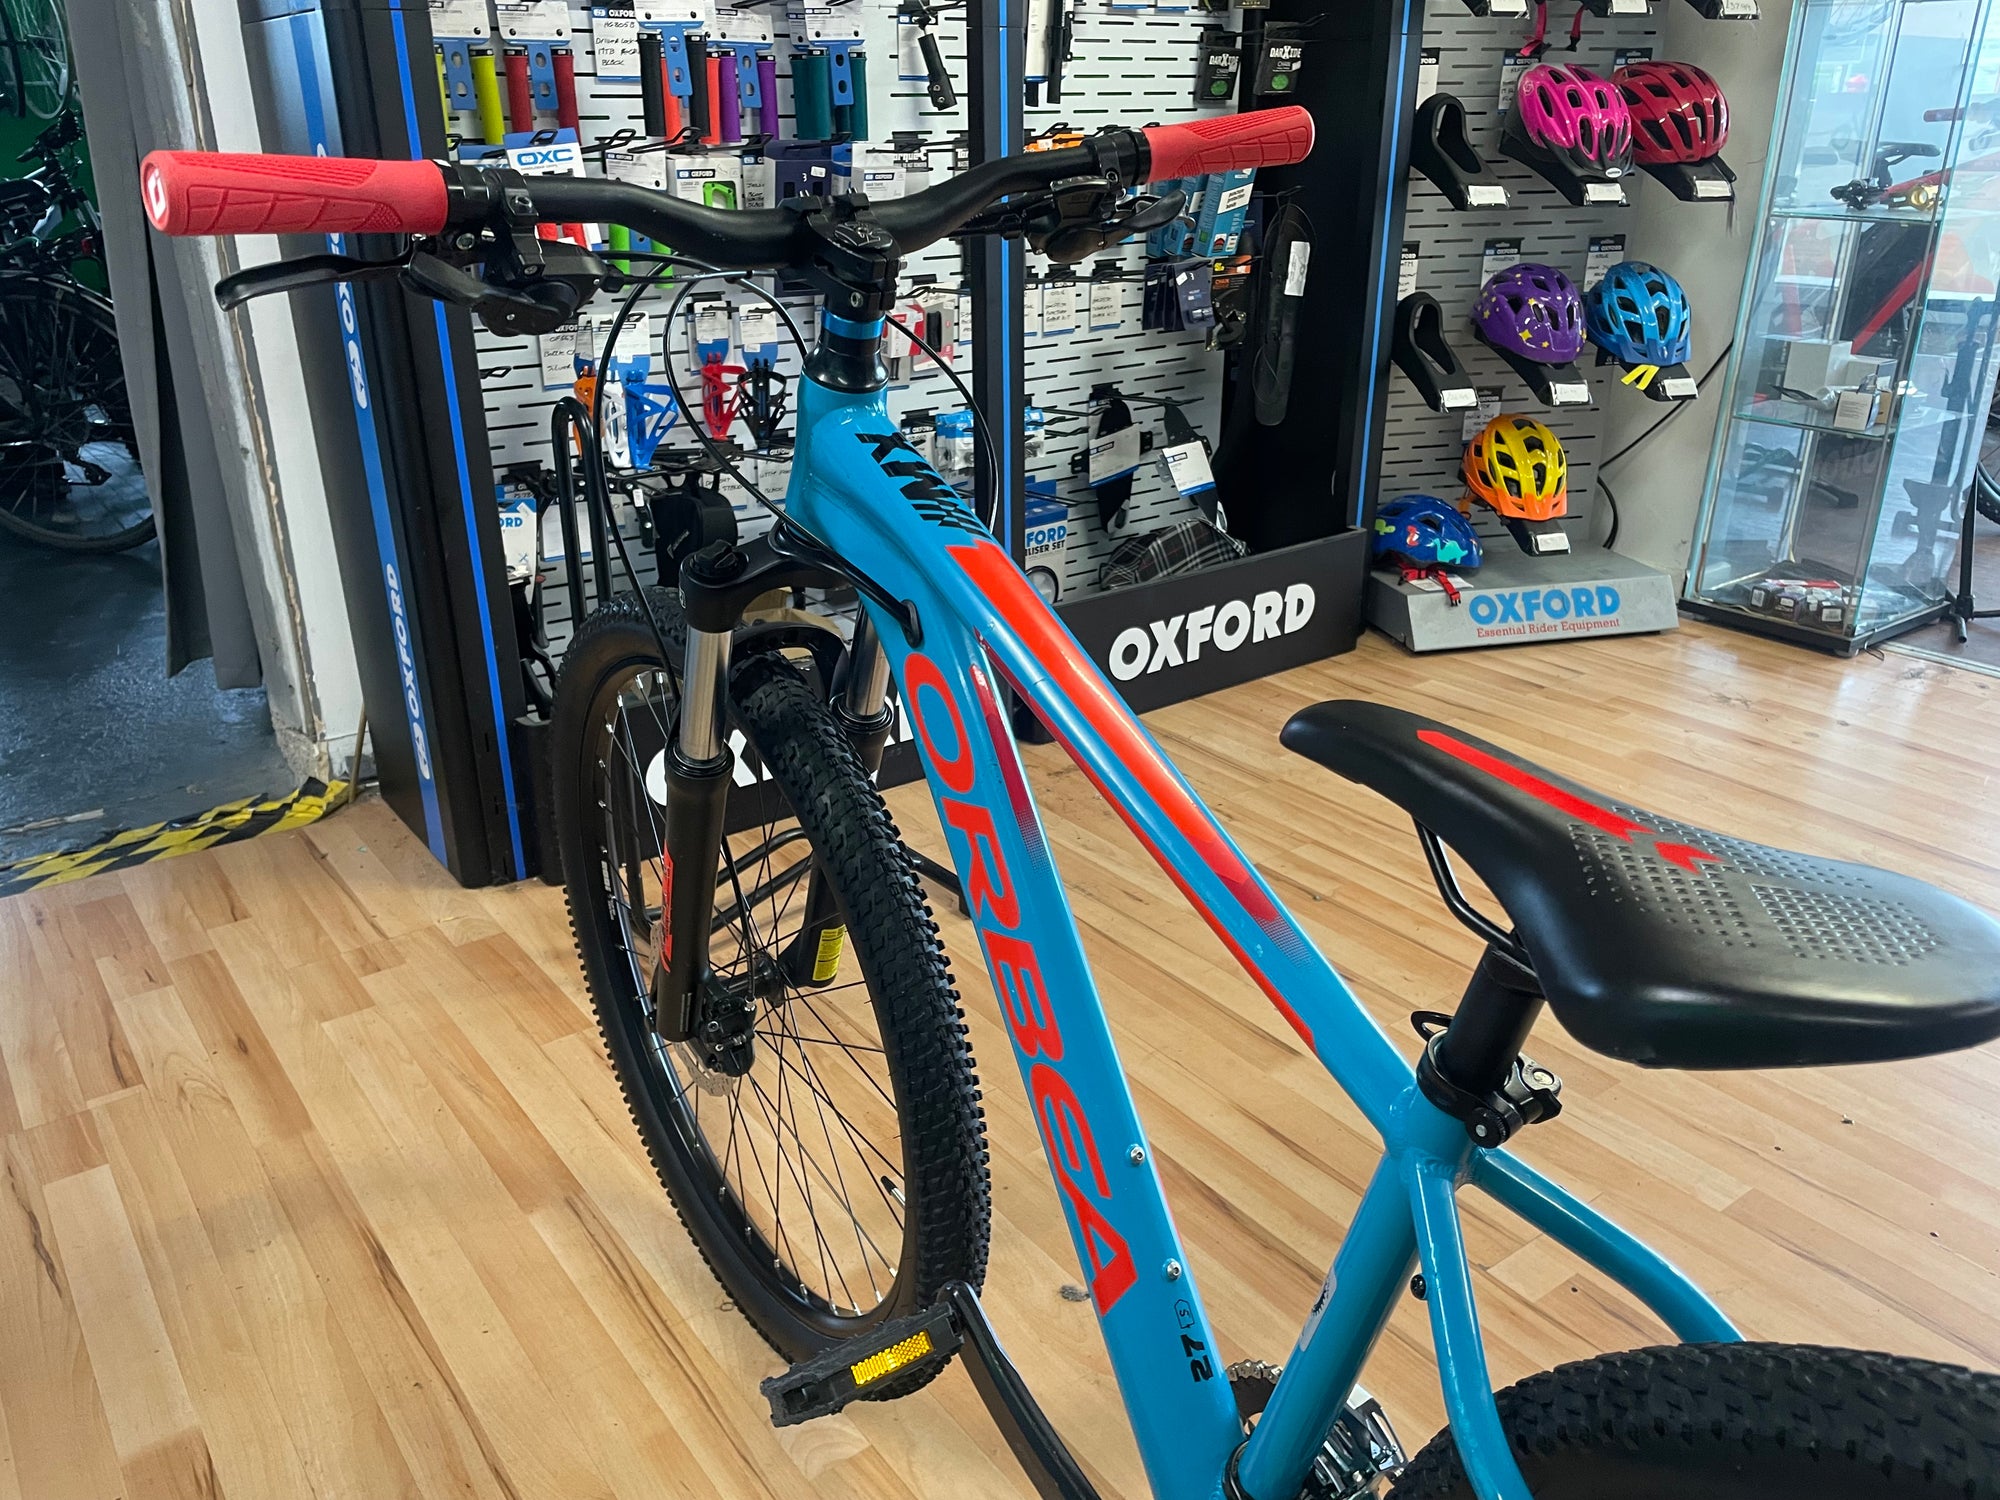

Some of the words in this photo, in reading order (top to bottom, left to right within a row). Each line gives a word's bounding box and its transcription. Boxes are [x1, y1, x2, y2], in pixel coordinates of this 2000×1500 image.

[608, 9, 636, 18] OXFOR
[517, 148, 574, 166] OXC
[1026, 525, 1067, 548] FORD
[1052, 540, 1066, 550] SET
[1468, 585, 1621, 626] OXFORD
[386, 563, 420, 719] OXFORD
[1108, 583, 1316, 681] OXFORD
[1476, 626, 1526, 639] Essential
[1529, 621, 1559, 634] Rider
[1561, 618, 1620, 633] Equipment
[903, 651, 1138, 1316] ORBEA
[1180, 1333, 1214, 1383] 27
